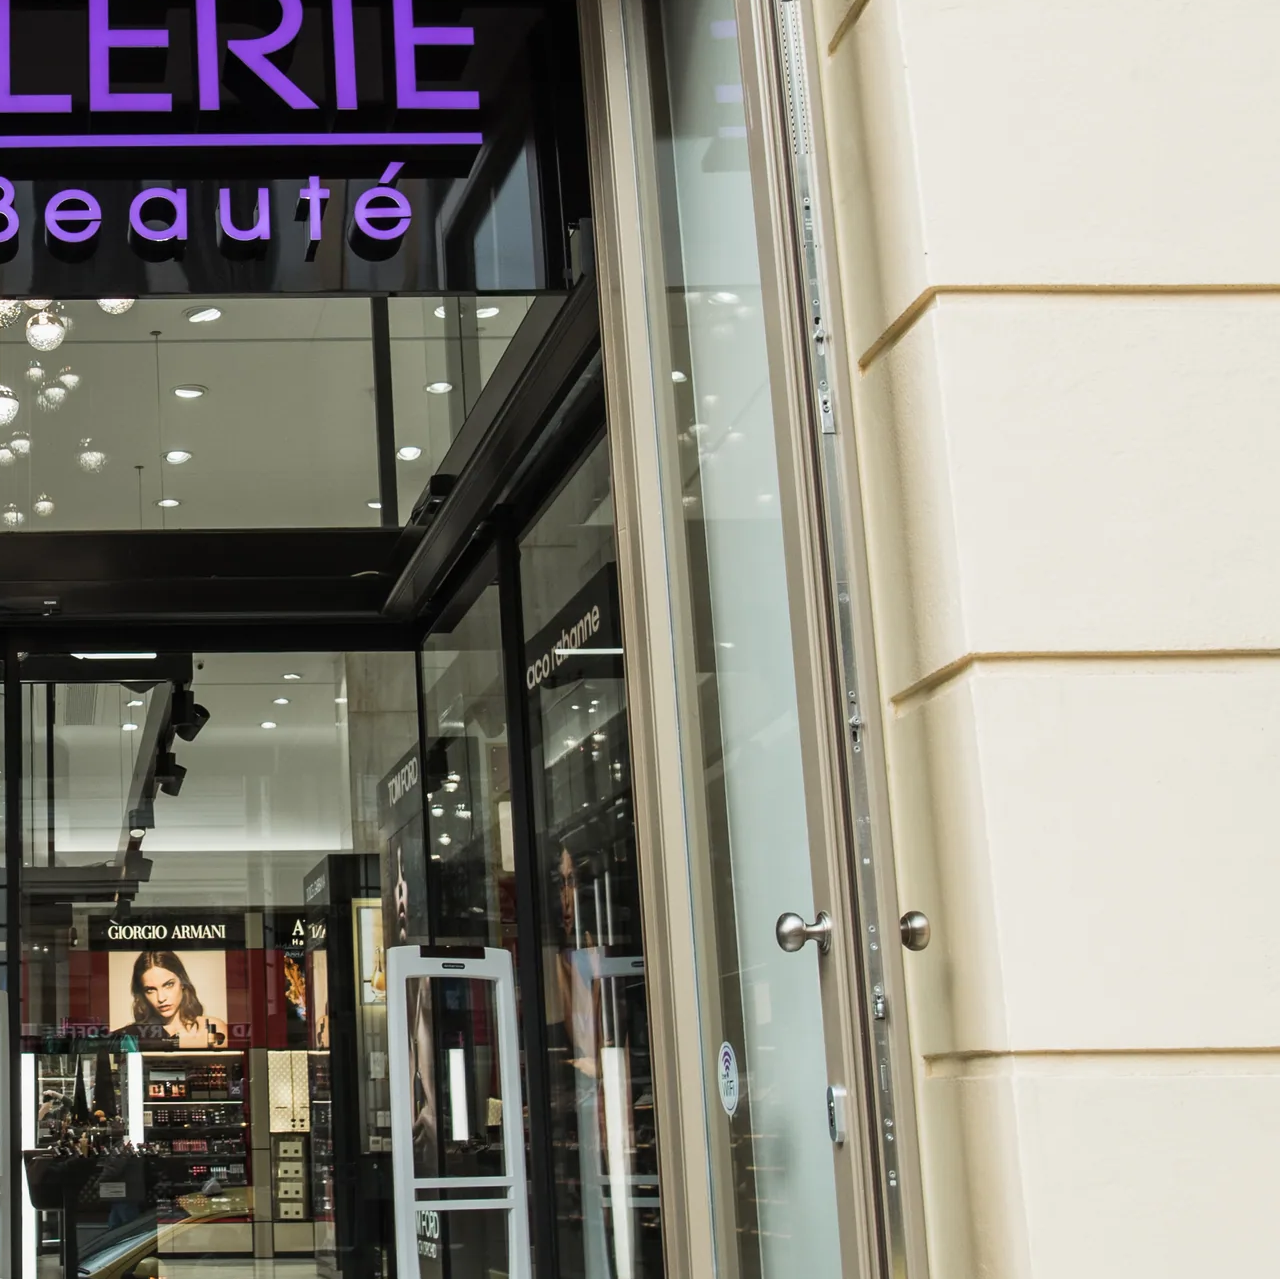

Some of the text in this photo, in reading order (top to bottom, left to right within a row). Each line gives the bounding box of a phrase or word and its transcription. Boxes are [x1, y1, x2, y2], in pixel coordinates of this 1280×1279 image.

[401, 756, 418, 796] FORD
[107, 924, 226, 939] GIORGIO ARMANI
